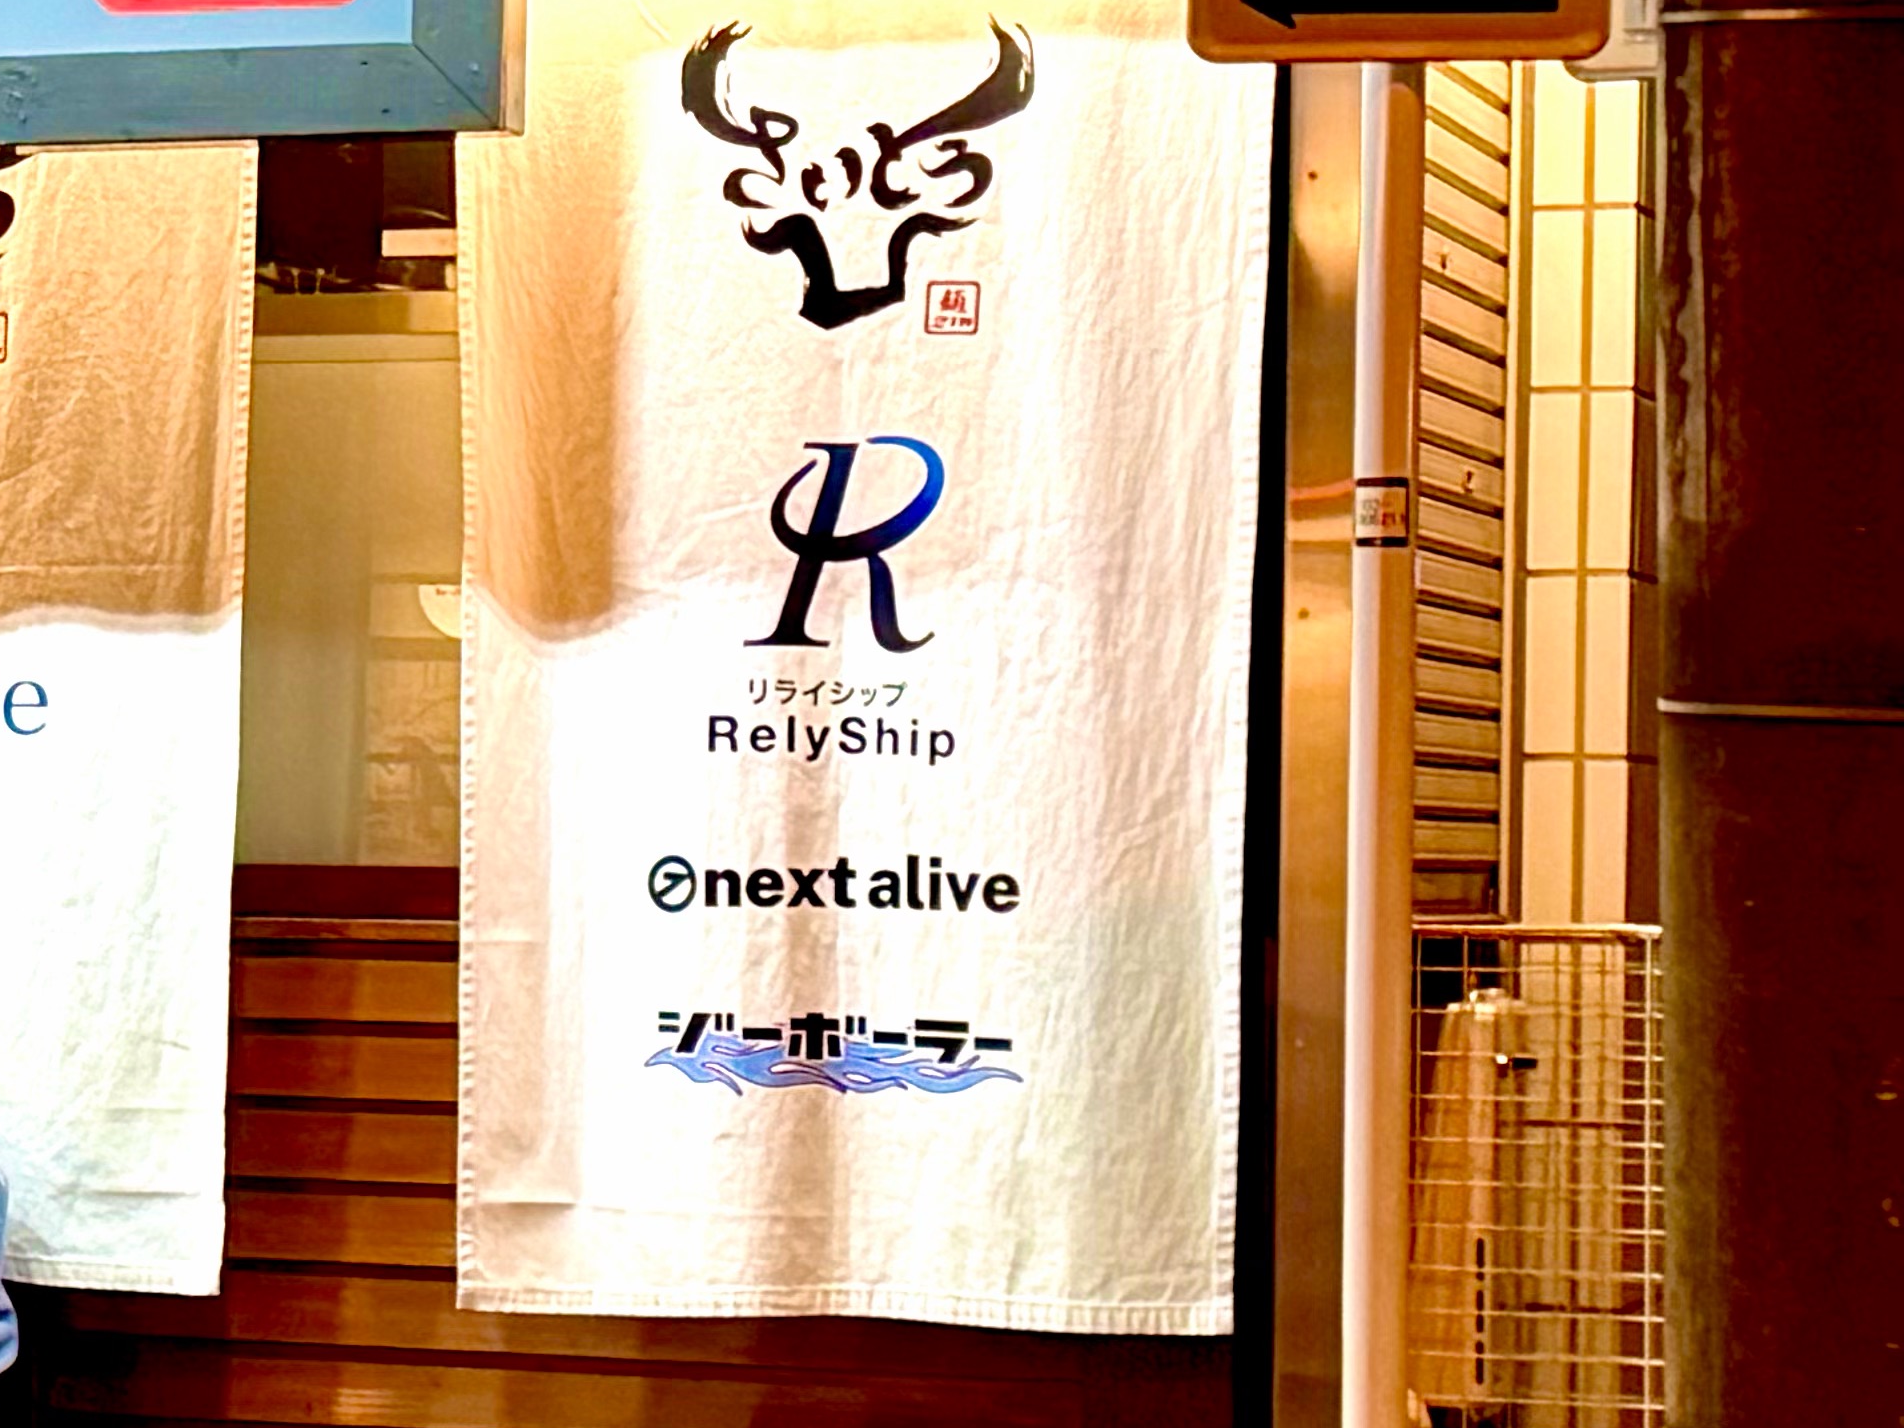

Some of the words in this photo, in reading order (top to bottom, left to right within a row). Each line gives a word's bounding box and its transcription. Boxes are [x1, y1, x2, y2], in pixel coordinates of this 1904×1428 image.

[748, 679, 909, 707] リライシップ
[708, 714, 956, 766] RelyShip
[658, 1011, 1013, 1064] ジーボーラー
